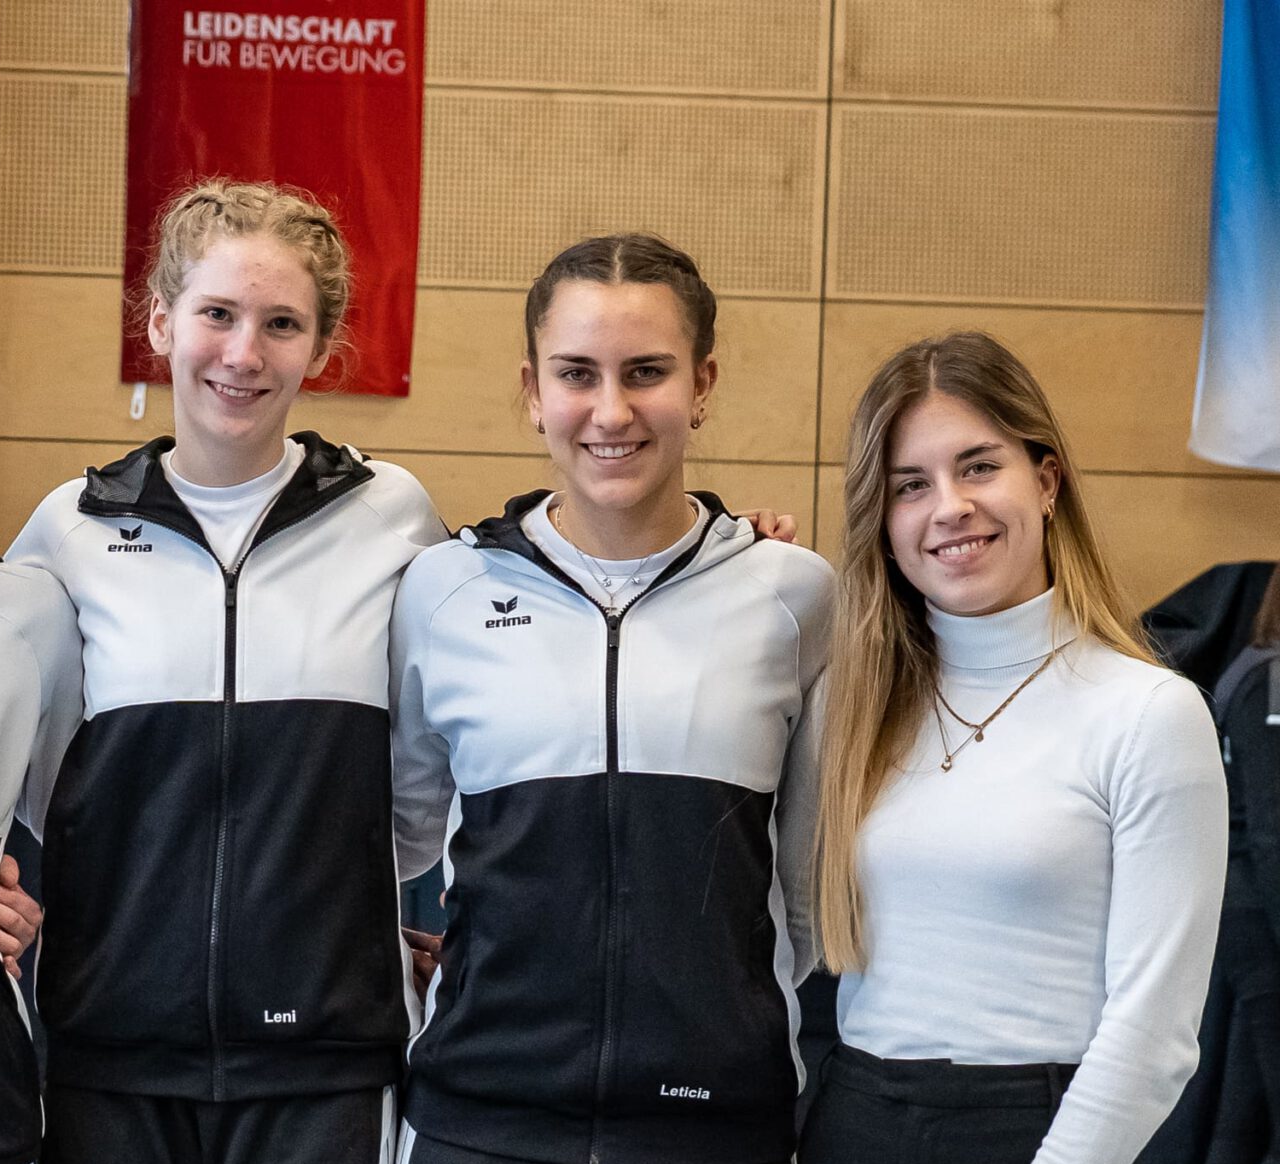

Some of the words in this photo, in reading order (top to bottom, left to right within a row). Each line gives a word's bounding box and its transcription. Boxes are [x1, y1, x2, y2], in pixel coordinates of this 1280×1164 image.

[183, 10, 396, 44] LEIDENSCHAFT
[239, 41, 406, 75] BEWEGUNG
[107, 543, 153, 553] erima
[485, 615, 531, 628] erima
[264, 1009, 297, 1023] Leni
[660, 1084, 711, 1100] Leticia
